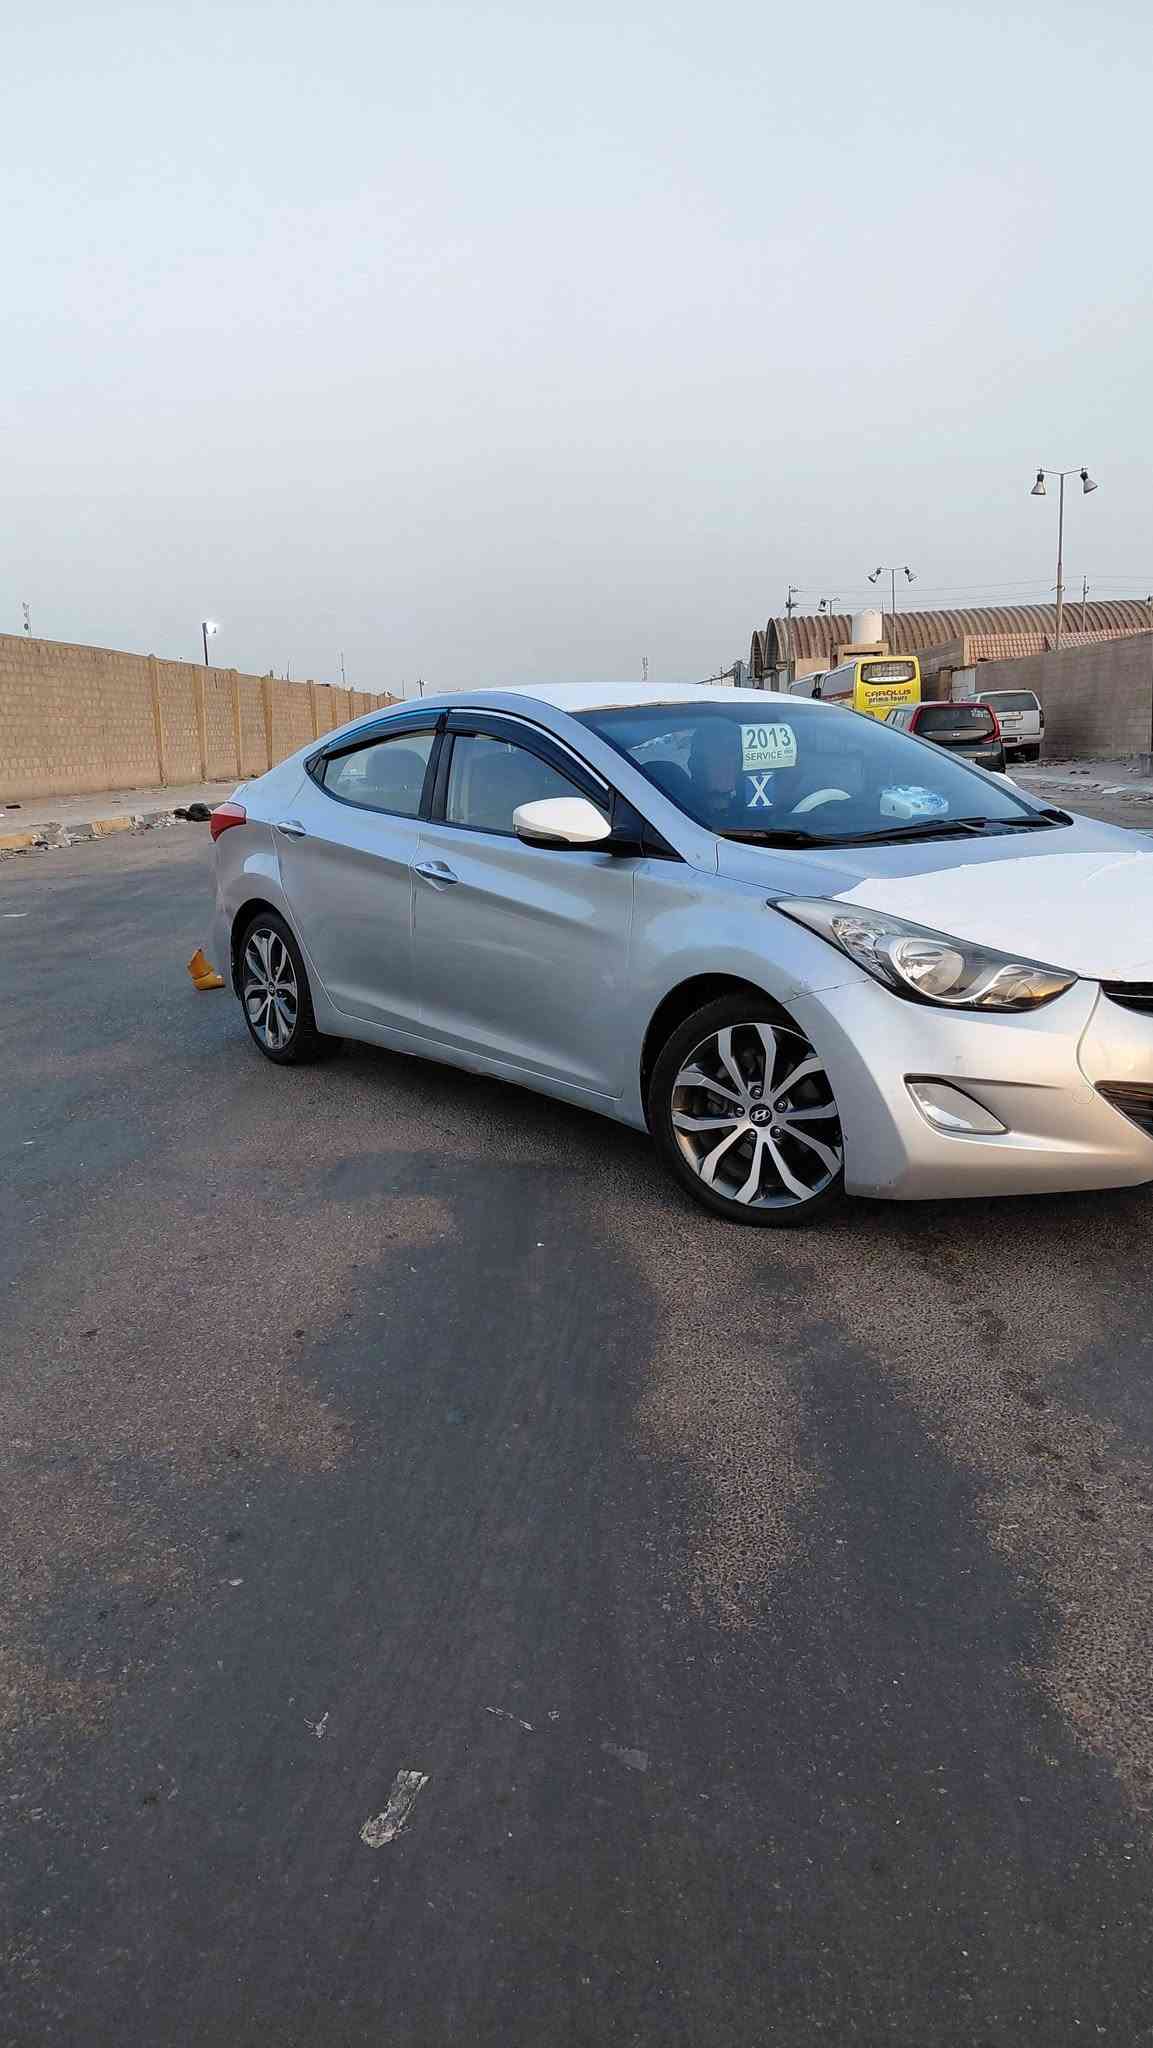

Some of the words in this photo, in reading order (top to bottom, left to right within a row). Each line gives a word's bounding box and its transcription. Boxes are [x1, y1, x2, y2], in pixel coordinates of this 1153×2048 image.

[865, 689, 911, 697] CAROLUS
[744, 727, 791, 749] 2013
[745, 751, 782, 761] SERVICE
[746, 774, 774, 807] X
